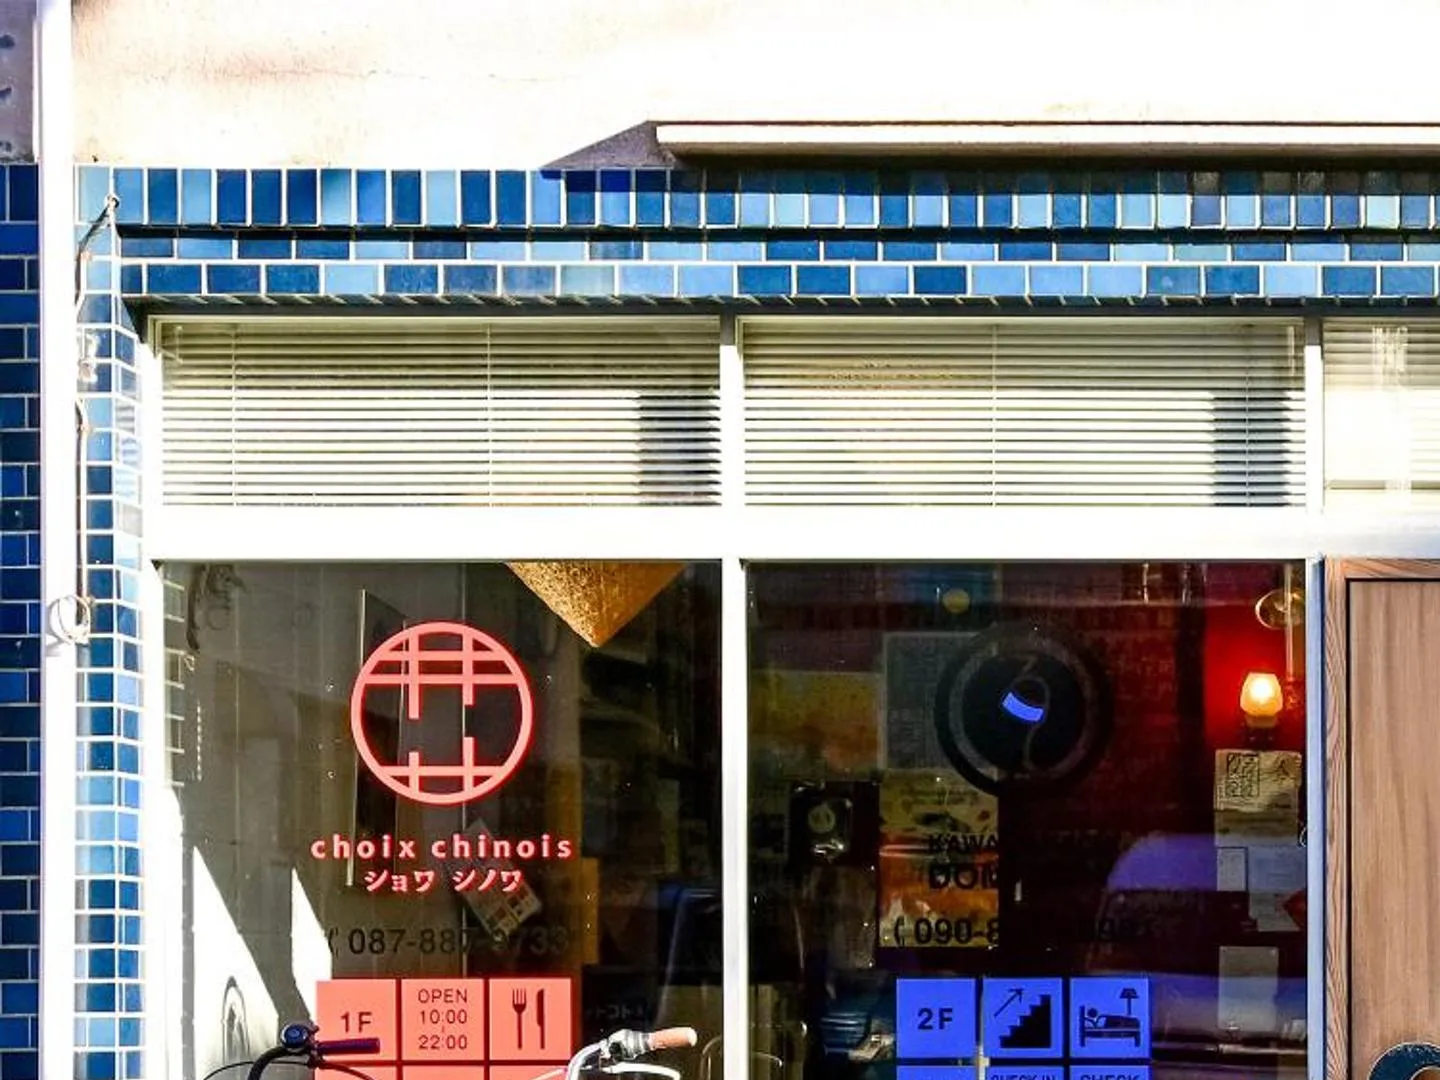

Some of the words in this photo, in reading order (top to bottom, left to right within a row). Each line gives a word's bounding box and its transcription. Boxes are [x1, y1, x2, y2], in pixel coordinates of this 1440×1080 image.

[310, 833, 416, 859] choix
[431, 833, 573, 859] chinois
[418, 988, 467, 1004] OPEN
[420, 1009, 467, 1024] 10:00
[917, 1007, 954, 1031] 2F
[419, 1034, 467, 1050] 22:00
